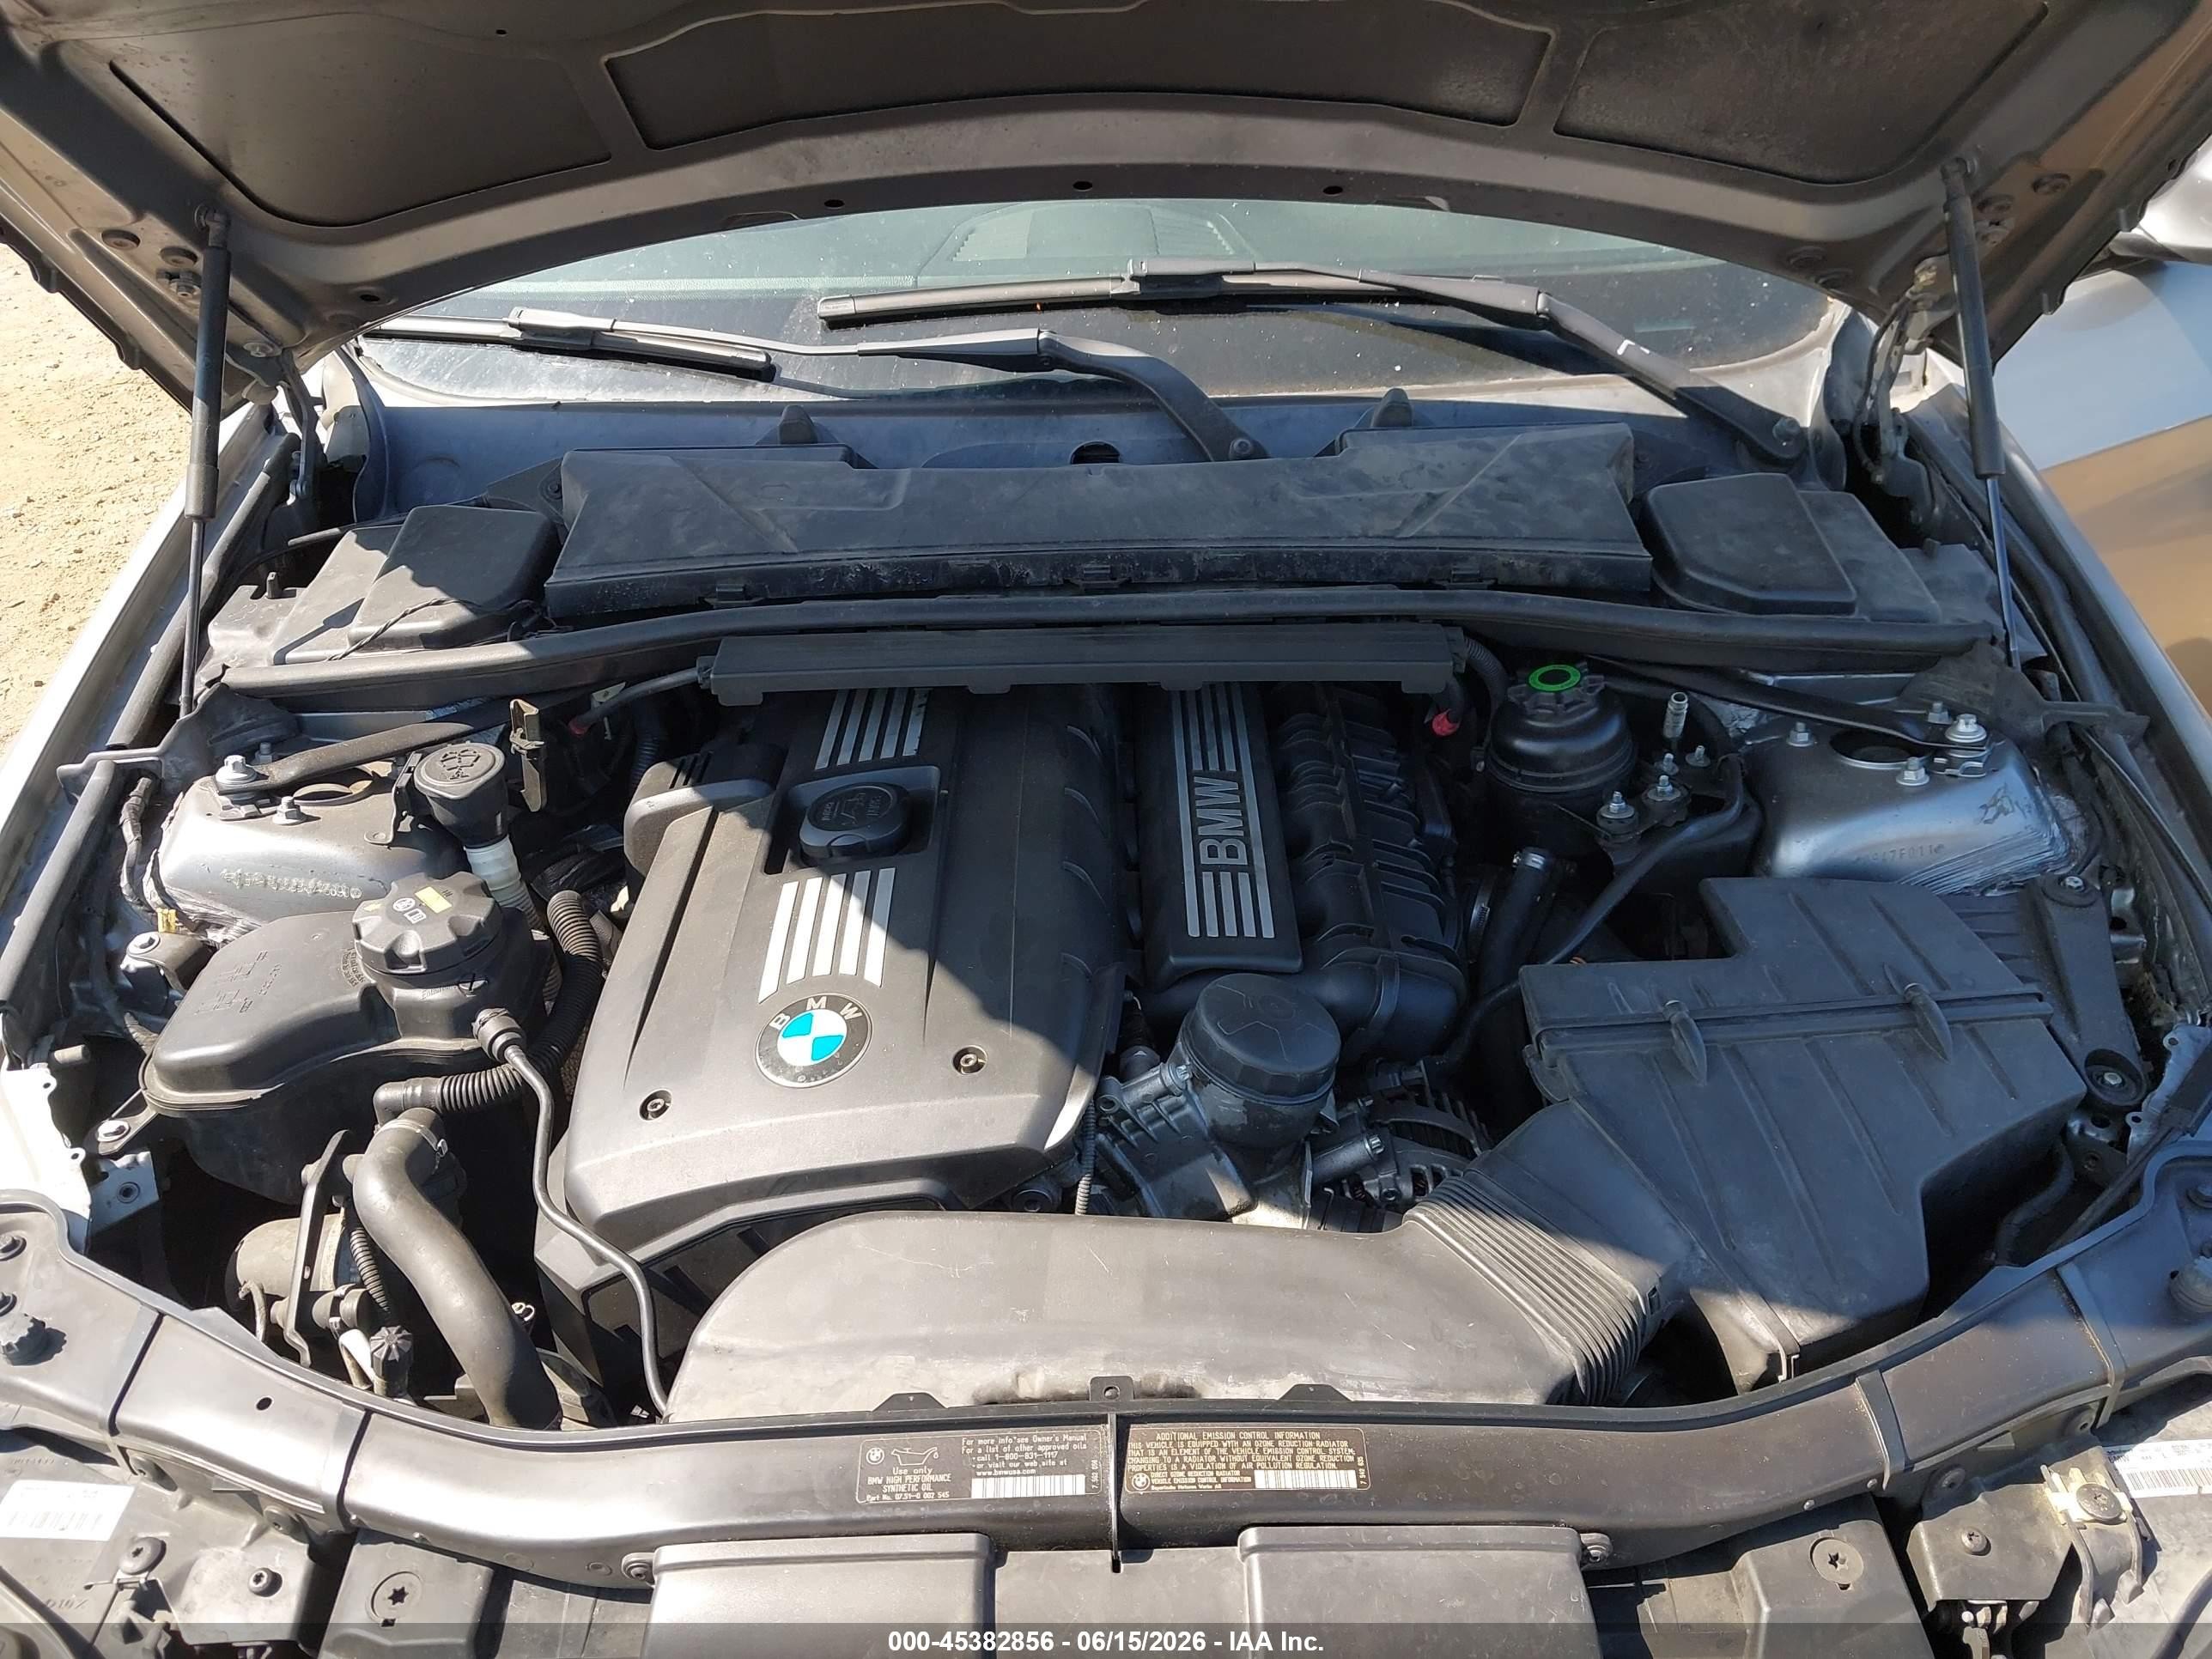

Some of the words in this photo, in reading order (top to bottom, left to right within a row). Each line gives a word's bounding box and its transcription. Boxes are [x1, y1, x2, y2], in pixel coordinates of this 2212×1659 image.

[1194, 776, 1248, 865] BMW
[769, 996, 862, 1030] BMW
[1156, 1432, 1198, 1441] ADDITIONAL
[962, 1438, 973, 1446] For
[962, 1446, 973, 1454] For
[1038, 1442, 1069, 1451] approved
[995, 1452, 1058, 1460] 1-800-831-1117
[914, 1466, 932, 1475] only
[867, 1477, 883, 1485] BMW
[886, 1476, 902, 1484] HIGH
[905, 1473, 951, 1483] PERFORMANCE
[882, 1484, 918, 1493] SYNTHETIC
